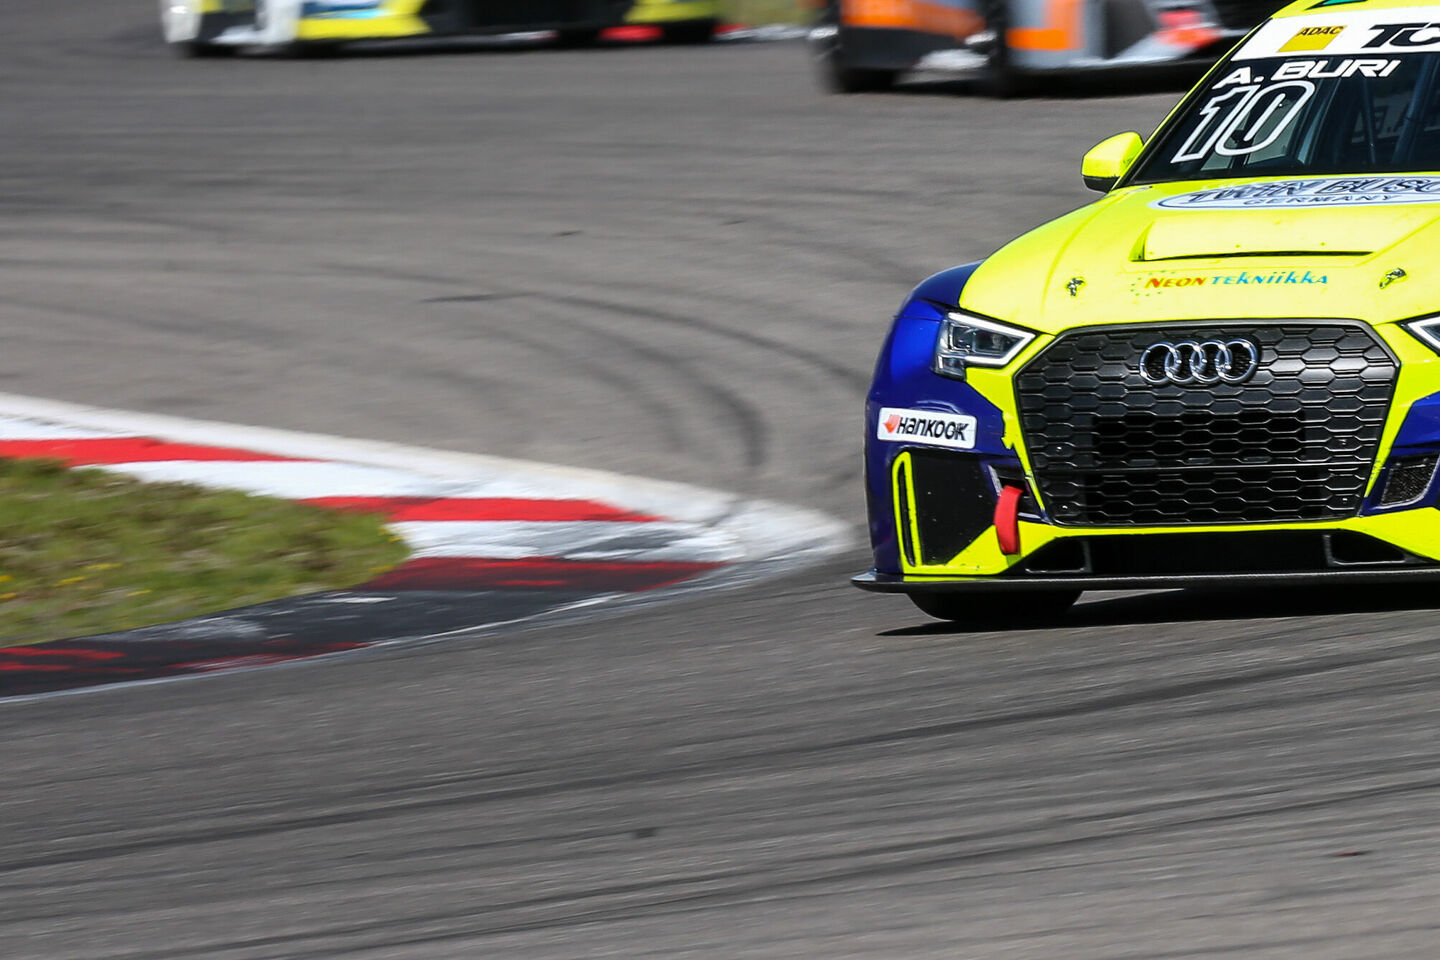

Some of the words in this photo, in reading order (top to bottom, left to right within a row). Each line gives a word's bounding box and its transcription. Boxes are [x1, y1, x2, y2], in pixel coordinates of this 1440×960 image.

[1297, 25, 1344, 37] ADAC
[1211, 66, 1265, 89] A.
[1269, 58, 1402, 79] BURI
[1170, 79, 1316, 164] 10
[1243, 194, 1402, 206] GERMANY
[1144, 276, 1208, 289] NEON
